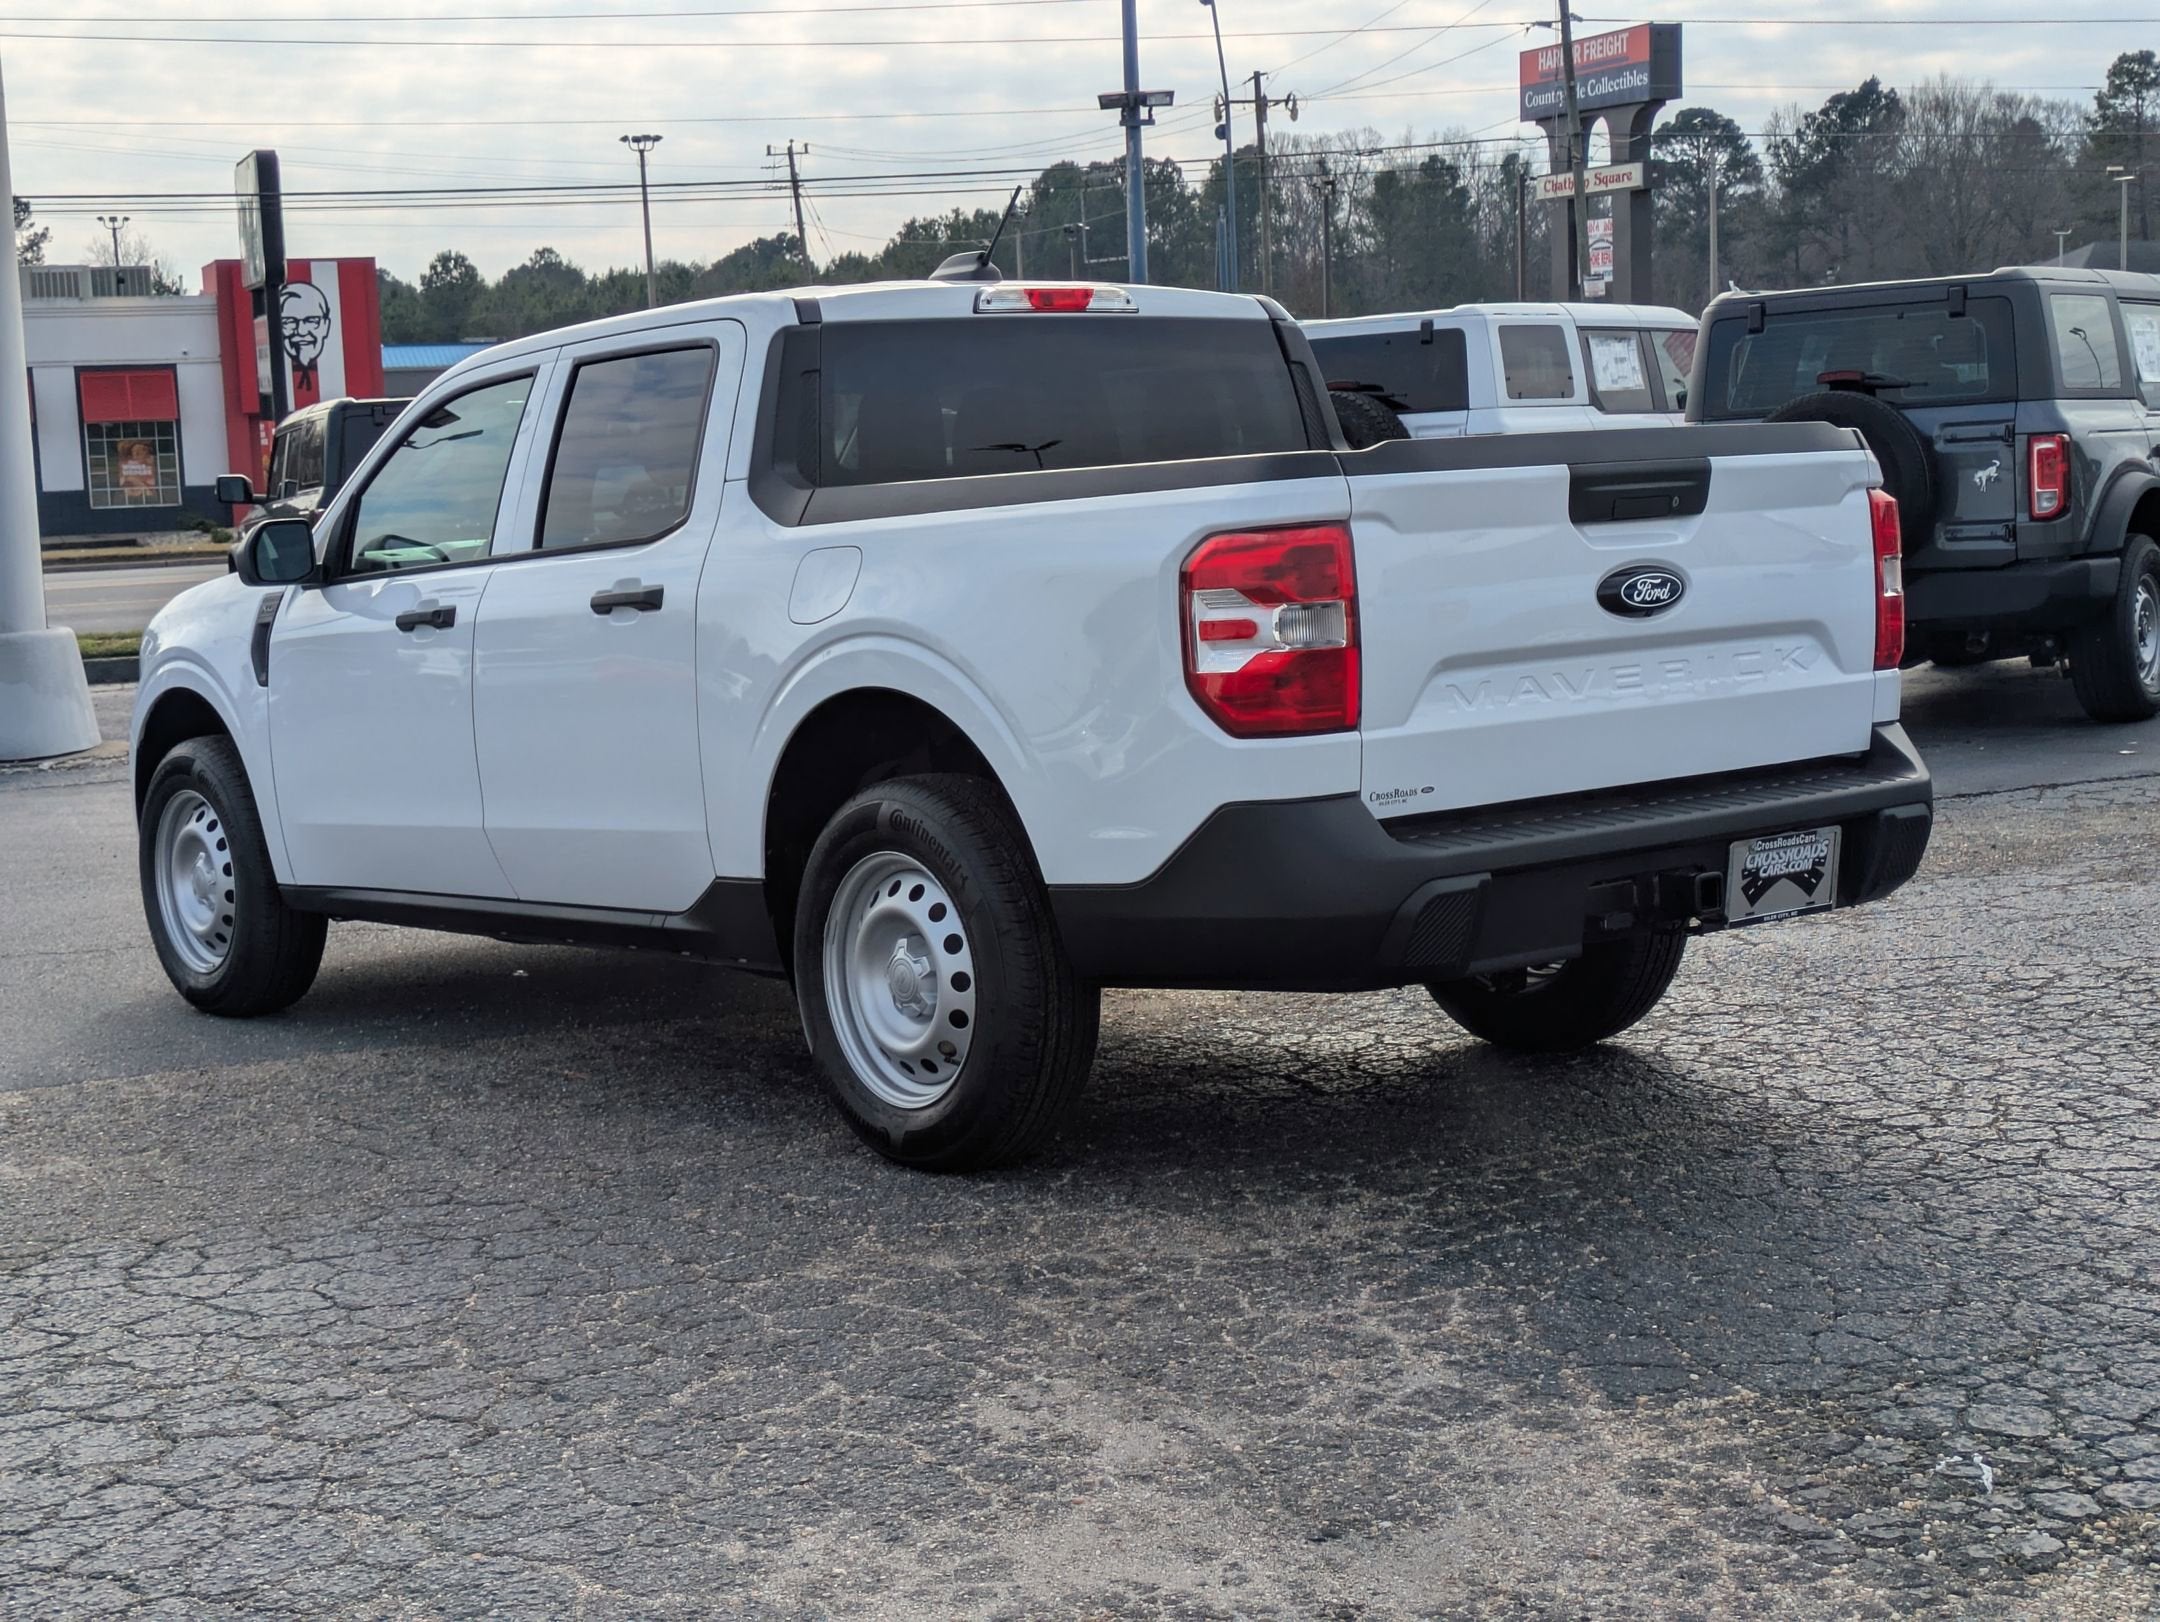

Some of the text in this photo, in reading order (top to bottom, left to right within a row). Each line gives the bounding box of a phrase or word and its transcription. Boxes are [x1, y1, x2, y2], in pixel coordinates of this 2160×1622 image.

[1538, 32, 1629, 71] HARR FREIGHT
[1525, 70, 1648, 108] Countrye Collectibles
[1543, 170, 1633, 193] Chath Square
[1634, 578, 1671, 602] Ford
[1444, 645, 1810, 714] MAVERICK
[889, 808, 962, 877] Continental
[1745, 839, 1829, 869] CROSSROADS
[1759, 858, 1814, 877] CARS.COM
